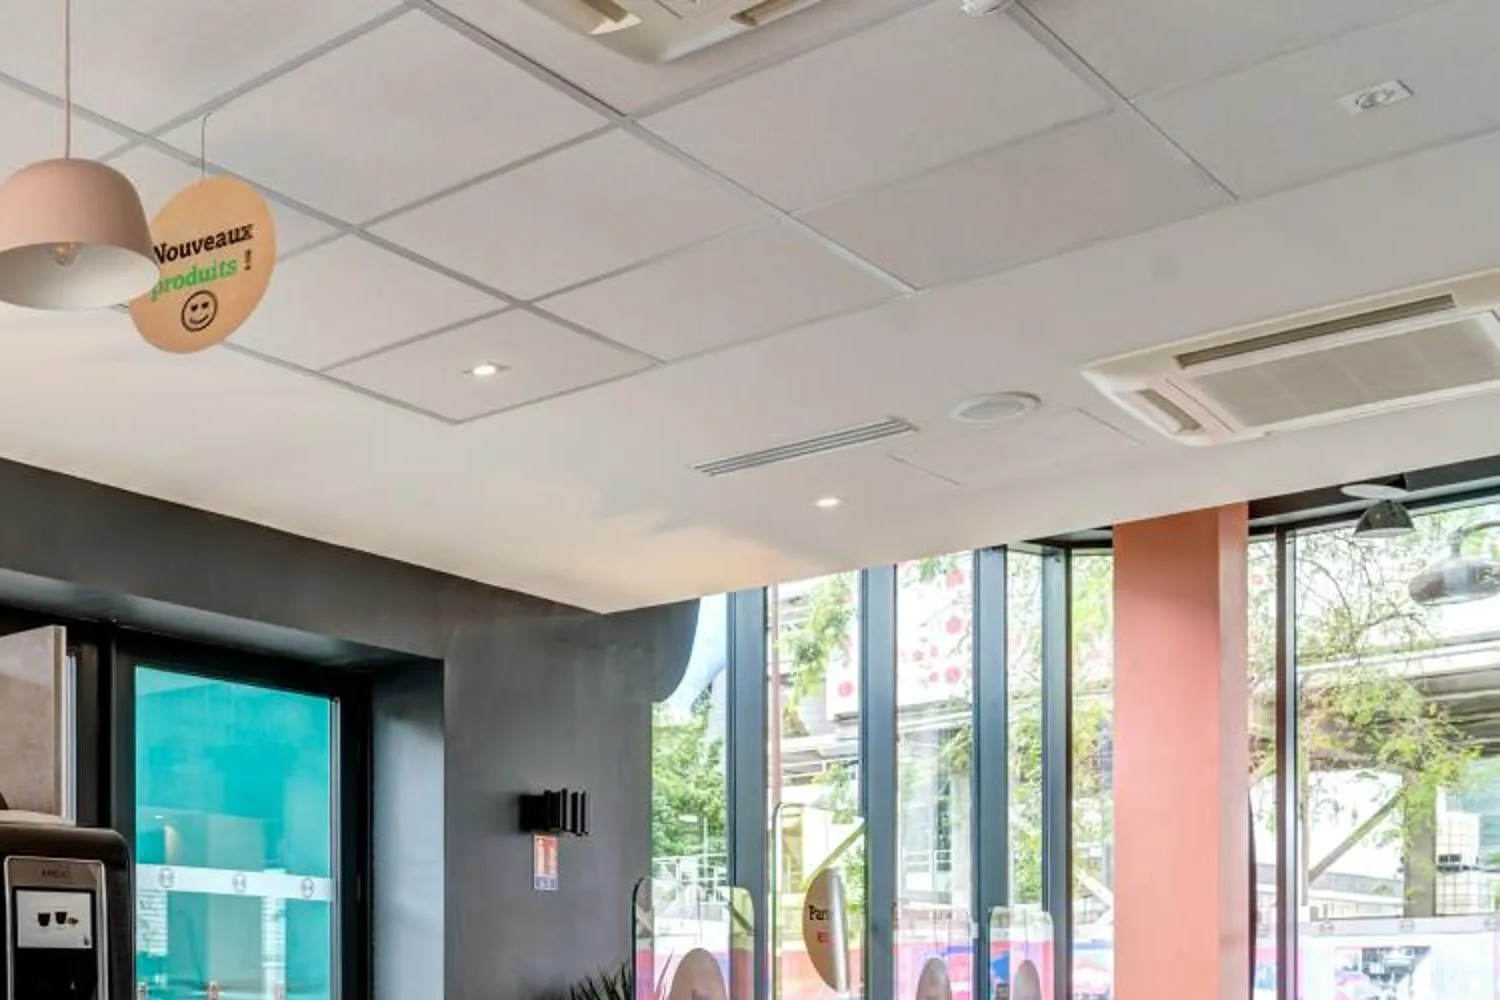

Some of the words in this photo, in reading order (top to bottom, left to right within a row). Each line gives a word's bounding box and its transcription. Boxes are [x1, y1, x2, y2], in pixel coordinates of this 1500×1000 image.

[153, 224, 254, 264] Nouveaux
[150, 258, 238, 302] produits
[243, 248, 252, 271] !
